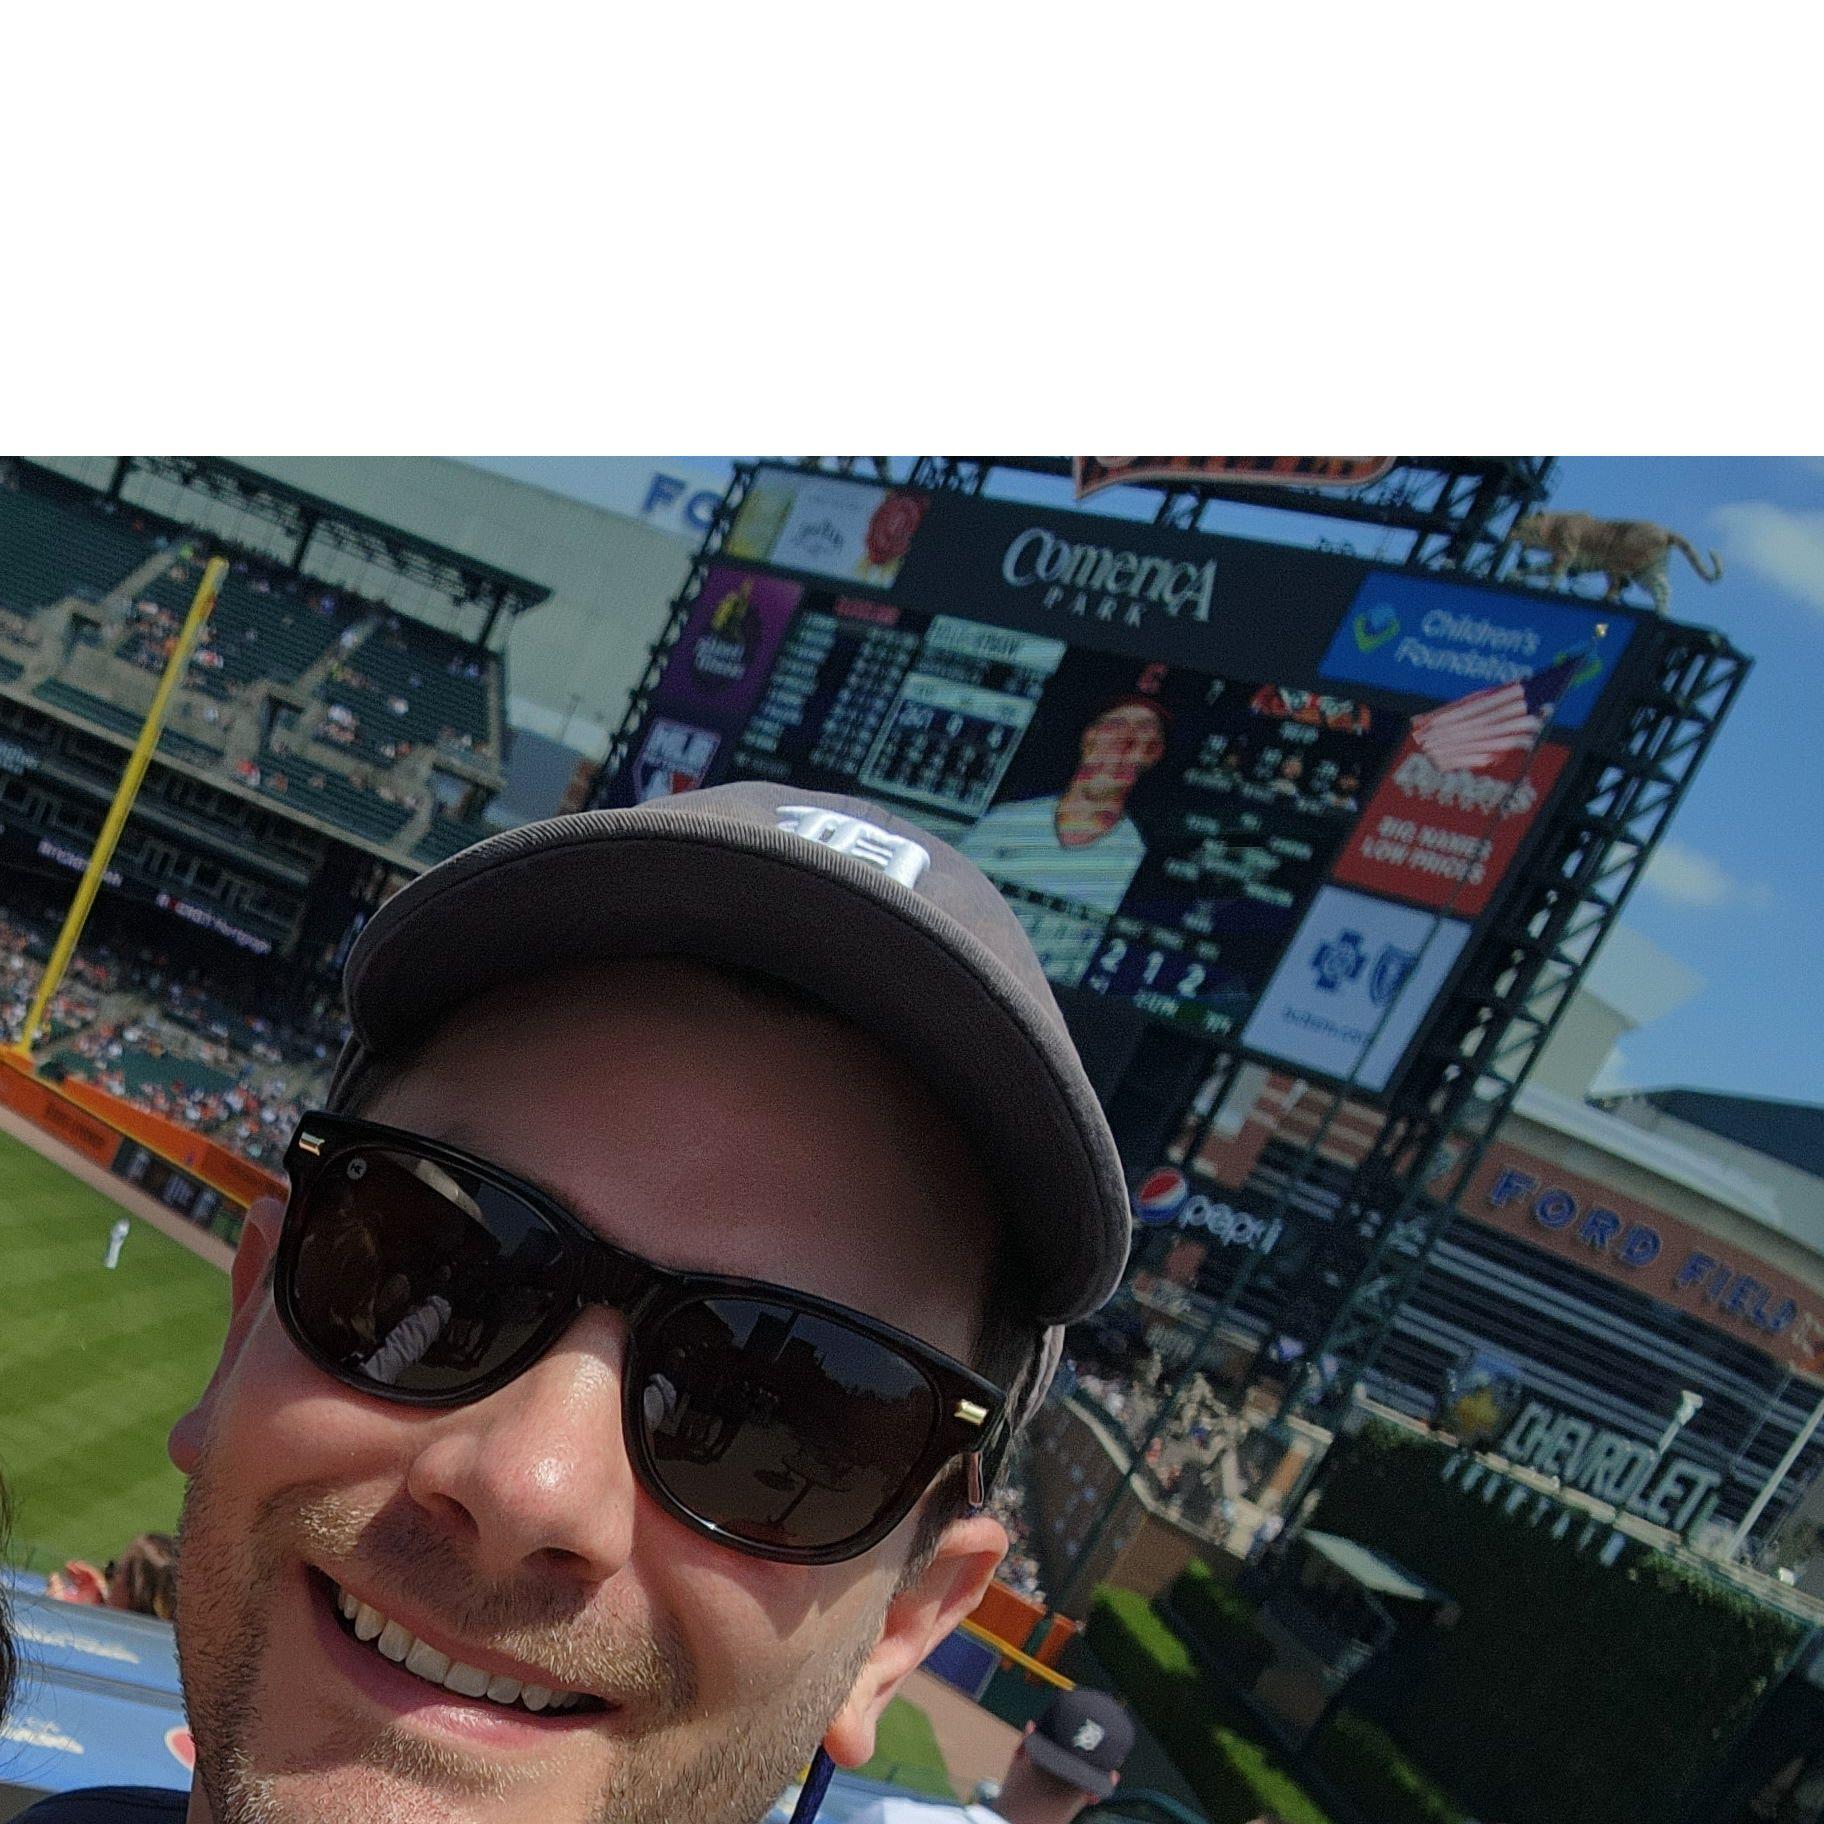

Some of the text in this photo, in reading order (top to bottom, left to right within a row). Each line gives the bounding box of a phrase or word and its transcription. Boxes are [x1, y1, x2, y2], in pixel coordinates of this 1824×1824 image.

[1043, 585, 1146, 629] PARK
[1177, 963, 1206, 999] 2
[1177, 1195, 1283, 1254] pepsi
[1490, 1166, 1799, 1333] FORD FIELD
[1501, 1401, 1723, 1531] CHEVROLET
